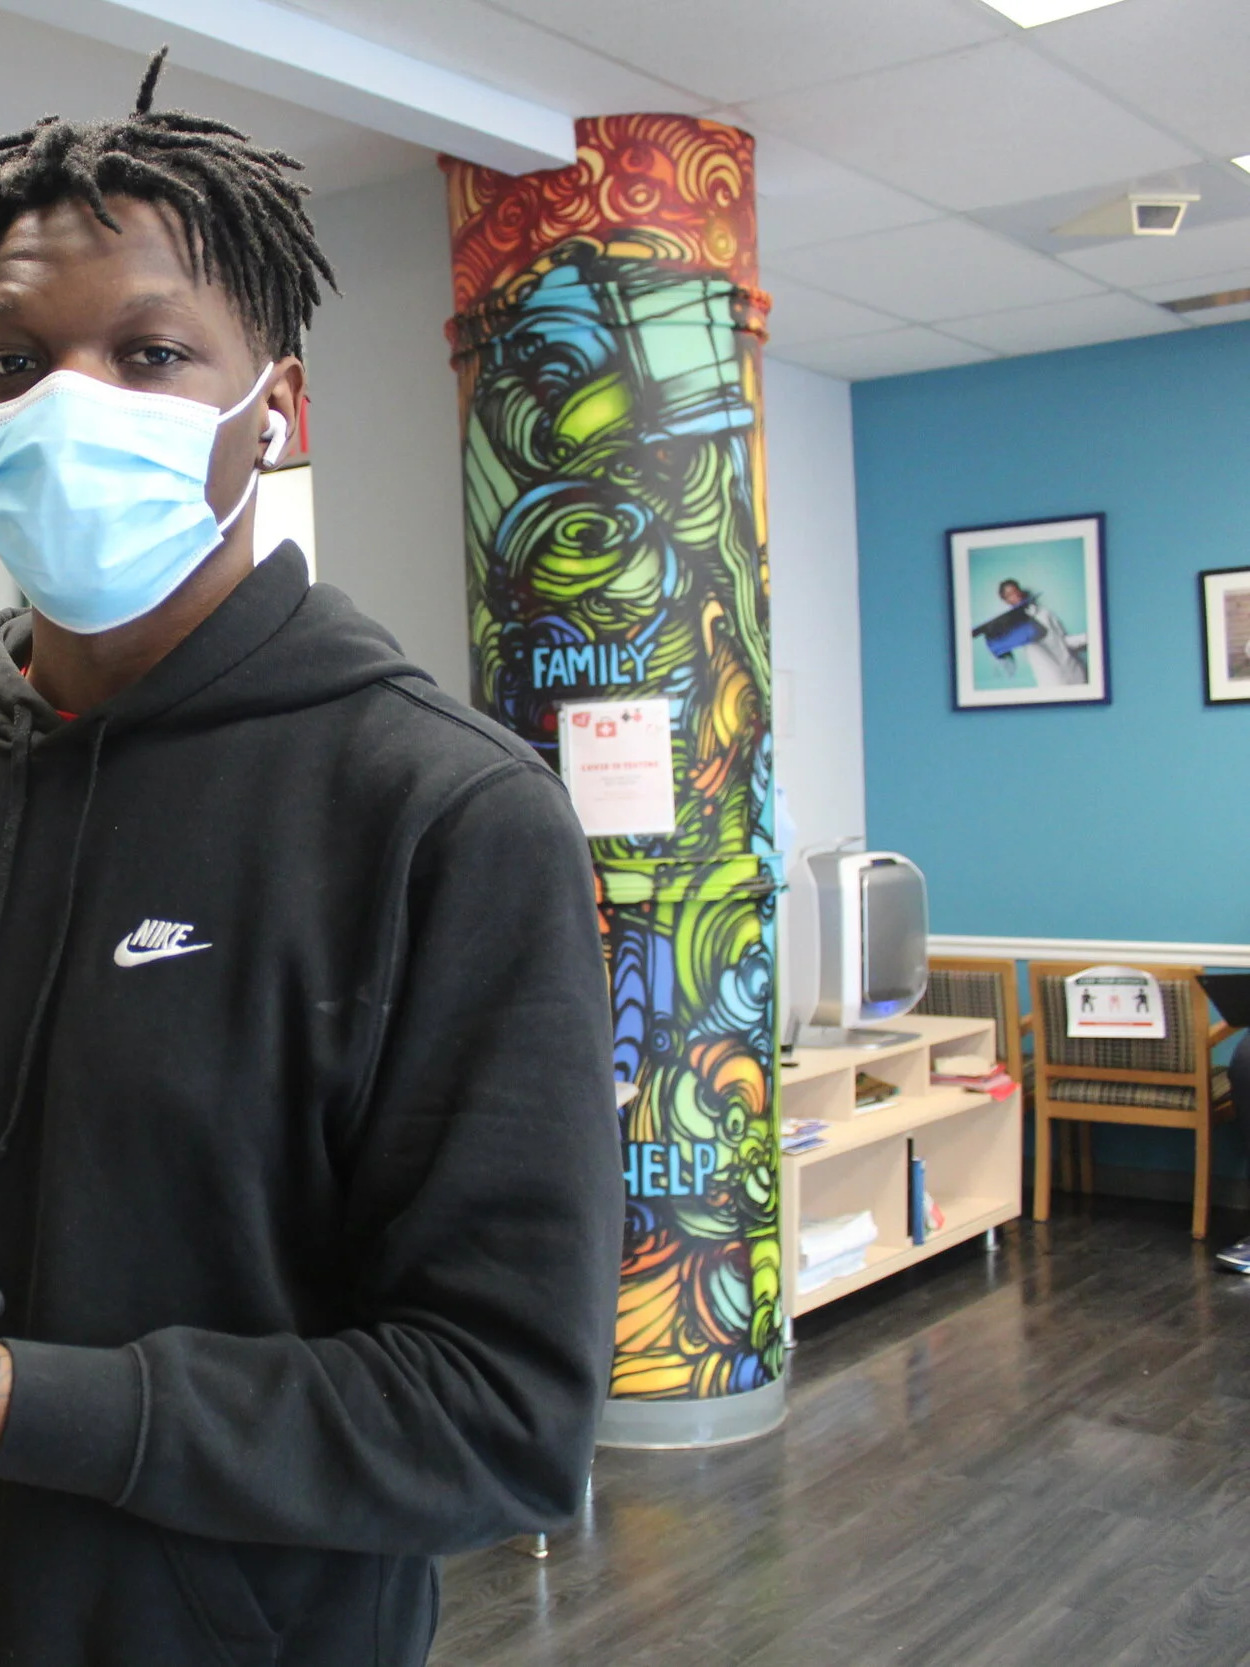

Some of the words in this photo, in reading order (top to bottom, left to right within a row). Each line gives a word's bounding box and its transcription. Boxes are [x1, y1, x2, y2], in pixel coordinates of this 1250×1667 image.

[532, 642, 655, 689] FAMILY
[130, 918, 194, 950] NIKE
[622, 1143, 716, 1197] HELP
